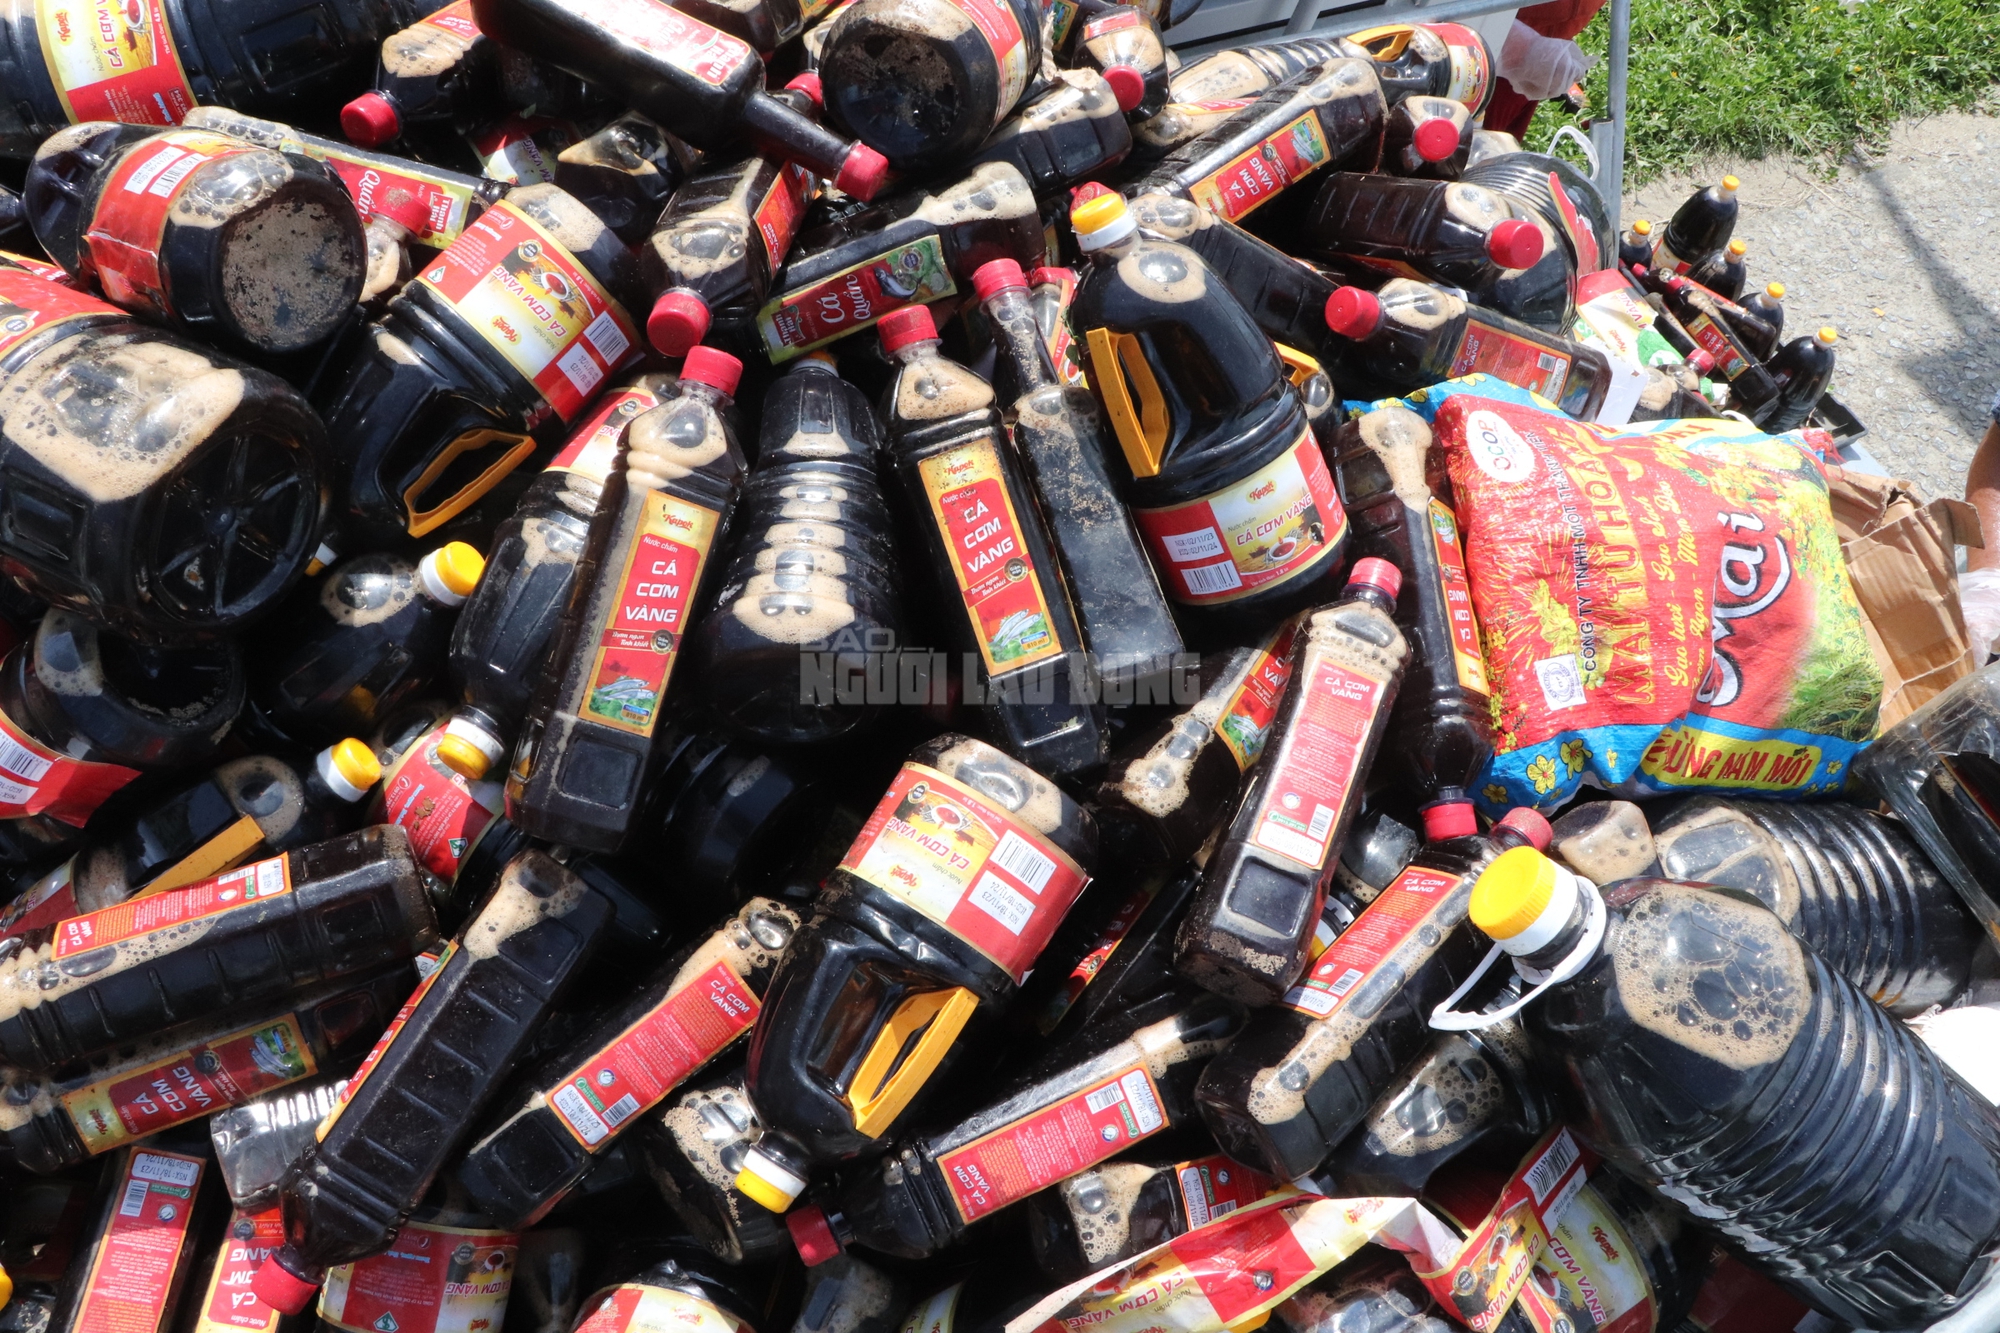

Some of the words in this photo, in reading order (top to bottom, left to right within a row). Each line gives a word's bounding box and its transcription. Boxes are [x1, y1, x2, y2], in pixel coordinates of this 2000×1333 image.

[95, 9, 116, 43] CƠM
[104, 47, 123, 69] CÁ
[1238, 167, 1260, 195] CƠM
[1248, 156, 1274, 191] VÀNG
[1227, 181, 1245, 200] CÁ
[435, 199, 449, 229] Thanh
[491, 263, 527, 300] VÀNG
[521, 292, 552, 323] CƠM
[814, 290, 847, 326] Cá
[1617, 293, 1640, 320] VÀNG
[547, 317, 568, 339] CÁ
[773, 313, 792, 343] Thanh
[962, 500, 989, 522] CÁ
[1234, 527, 1253, 546] CÁ
[1254, 515, 1284, 537] CƠM
[1283, 492, 1313, 521] VÀNG
[1563, 504, 1587, 540] MỘT
[1634, 494, 1675, 539] Sạch
[644, 536, 659, 549] Nước
[661, 541, 677, 554] chấm
[961, 517, 1004, 548] CƠM
[1675, 515, 1702, 568] Mềm
[652, 557, 677, 576] CÁ
[967, 537, 1014, 574] VÀNG
[1649, 537, 1681, 584] Gạo
[1571, 547, 1590, 594] TNHH
[636, 580, 678, 602] CƠM
[1449, 589, 1466, 601] VÀNG
[623, 604, 677, 623] VÀNG
[1454, 608, 1468, 619] CƠM
[1577, 596, 1593, 617] TY
[1668, 598, 1688, 640] tươi
[1688, 586, 1712, 640] Ngon
[1460, 627, 1470, 639] CÁ
[1579, 621, 1597, 672] CÔNG
[1608, 615, 1656, 705] MAI
[1662, 640, 1691, 687] Gạo
[1325, 673, 1342, 687] CÁ
[1345, 679, 1369, 694] CƠM
[1331, 684, 1362, 702] VÀNG
[1767, 745, 1815, 785] MỚI
[885, 815, 920, 844] VÀNG
[917, 833, 950, 858] CƠM
[931, 861, 948, 876] chấm
[946, 849, 970, 872] CÁ
[947, 870, 962, 884] Nước
[1403, 876, 1418, 886] CÁ
[1420, 877, 1445, 886] CƠM
[1406, 882, 1434, 894] VÀNG
[67, 920, 79, 936] CƠM
[71, 934, 83, 947] CÁ
[78, 920, 93, 936] VÀNG
[709, 991, 737, 1017] VÀNG
[710, 977, 727, 993] CÁ
[726, 992, 749, 1013] CƠM
[153, 1075, 186, 1115] CƠM
[171, 1063, 212, 1108] VÀNG
[133, 1090, 158, 1117] CÁ
[140, 1164, 187, 1180] NSX:18/11/23
[953, 1165, 973, 1189] CƠM
[966, 1164, 990, 1192] VÀNG
[970, 1190, 985, 1205] CÁ
[230, 1242, 270, 1266] ÀNG
[1526, 1233, 1542, 1253] CÁ
[1160, 1270, 1184, 1295] CÁ
[1503, 1253, 1530, 1289] CƠM
[1546, 1235, 1580, 1276] CƠM
[1573, 1276, 1608, 1323] VÀNG
[230, 1290, 256, 1310] CÁ
[446, 1281, 477, 1296] VÀNG
[1174, 1287, 1191, 1303] Nước
[1117, 1287, 1159, 1316] CƠM
[1153, 1298, 1174, 1313] chấm
[1468, 1295, 1508, 1329] VÀNG
[231, 1313, 248, 1324] chấm
[250, 1317, 265, 1328] Nước
[1068, 1305, 1115, 1332] VÀNG
